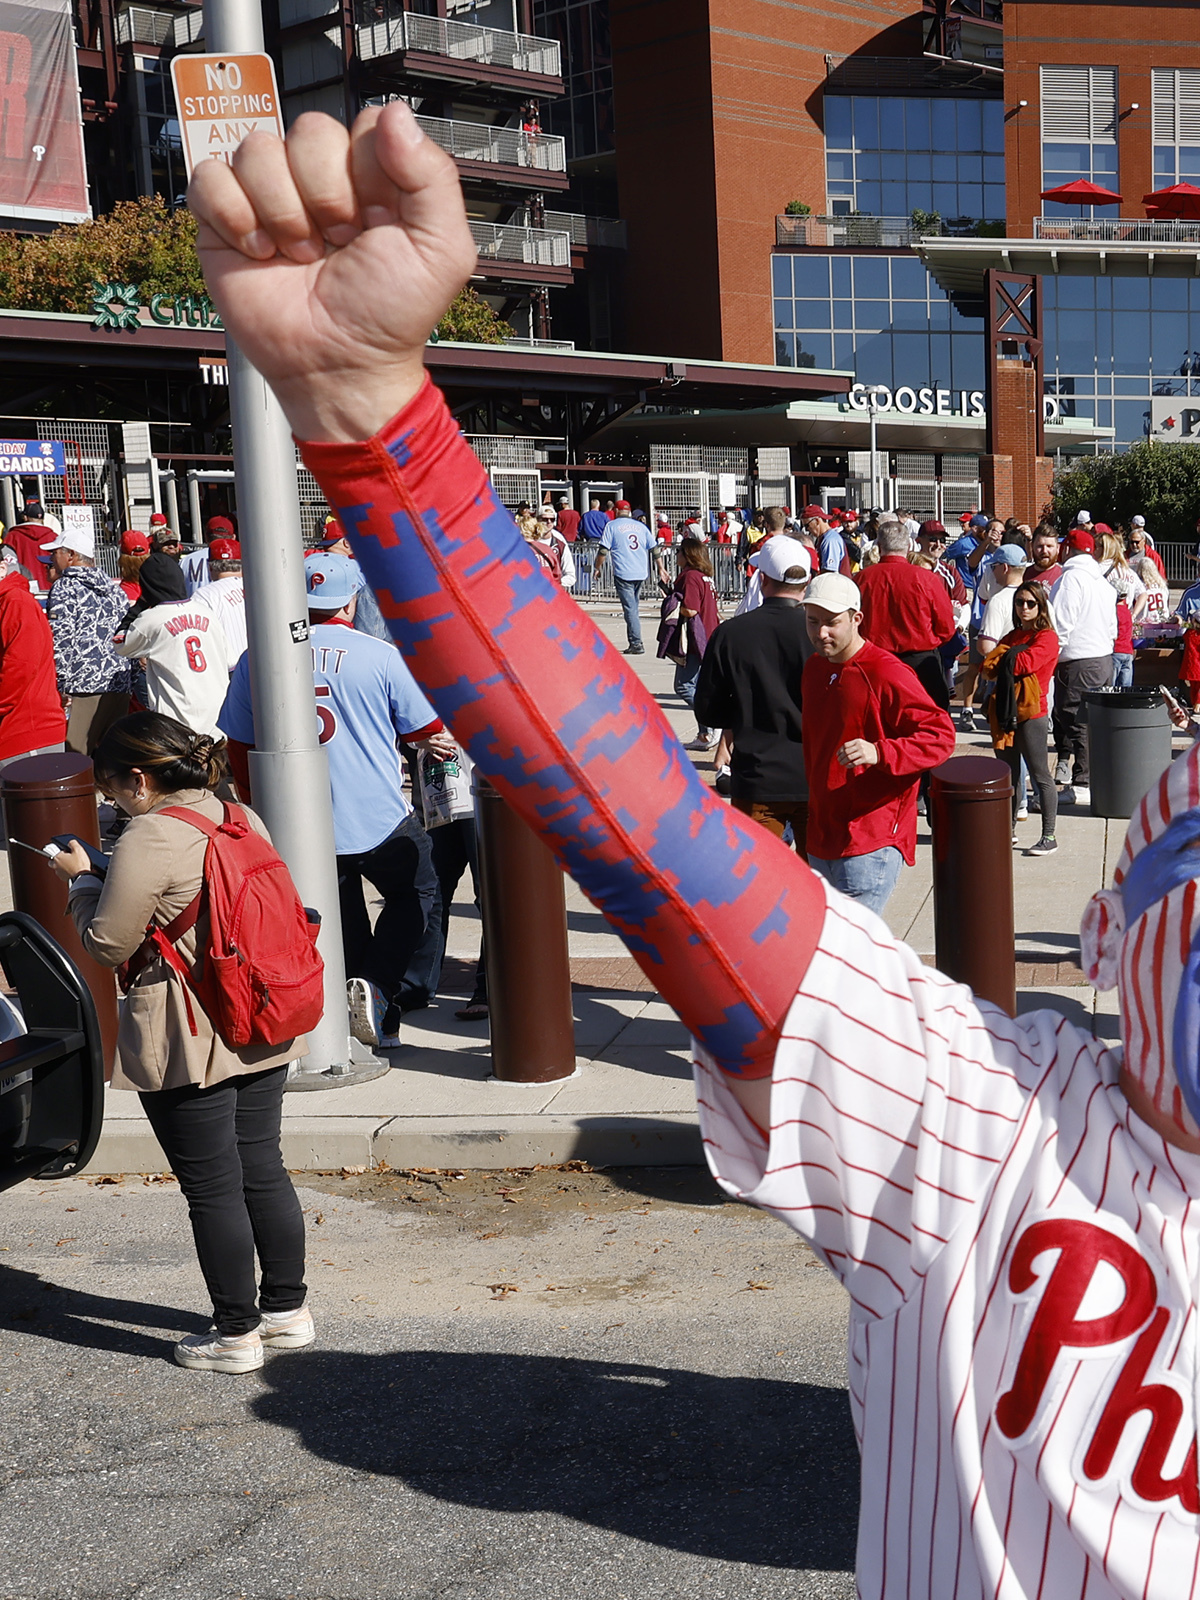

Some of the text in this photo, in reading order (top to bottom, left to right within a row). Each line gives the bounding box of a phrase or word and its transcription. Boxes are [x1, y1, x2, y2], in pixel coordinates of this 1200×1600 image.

[204, 62, 242, 91] NO
[184, 93, 273, 116] STOPPING
[151, 293, 223, 327] Citi
[850, 383, 951, 416] GOOSE
[66, 514, 91, 522] NLDS
[629, 533, 640, 551] 3
[164, 614, 210, 637] HOWARD
[183, 635, 207, 673] 6
